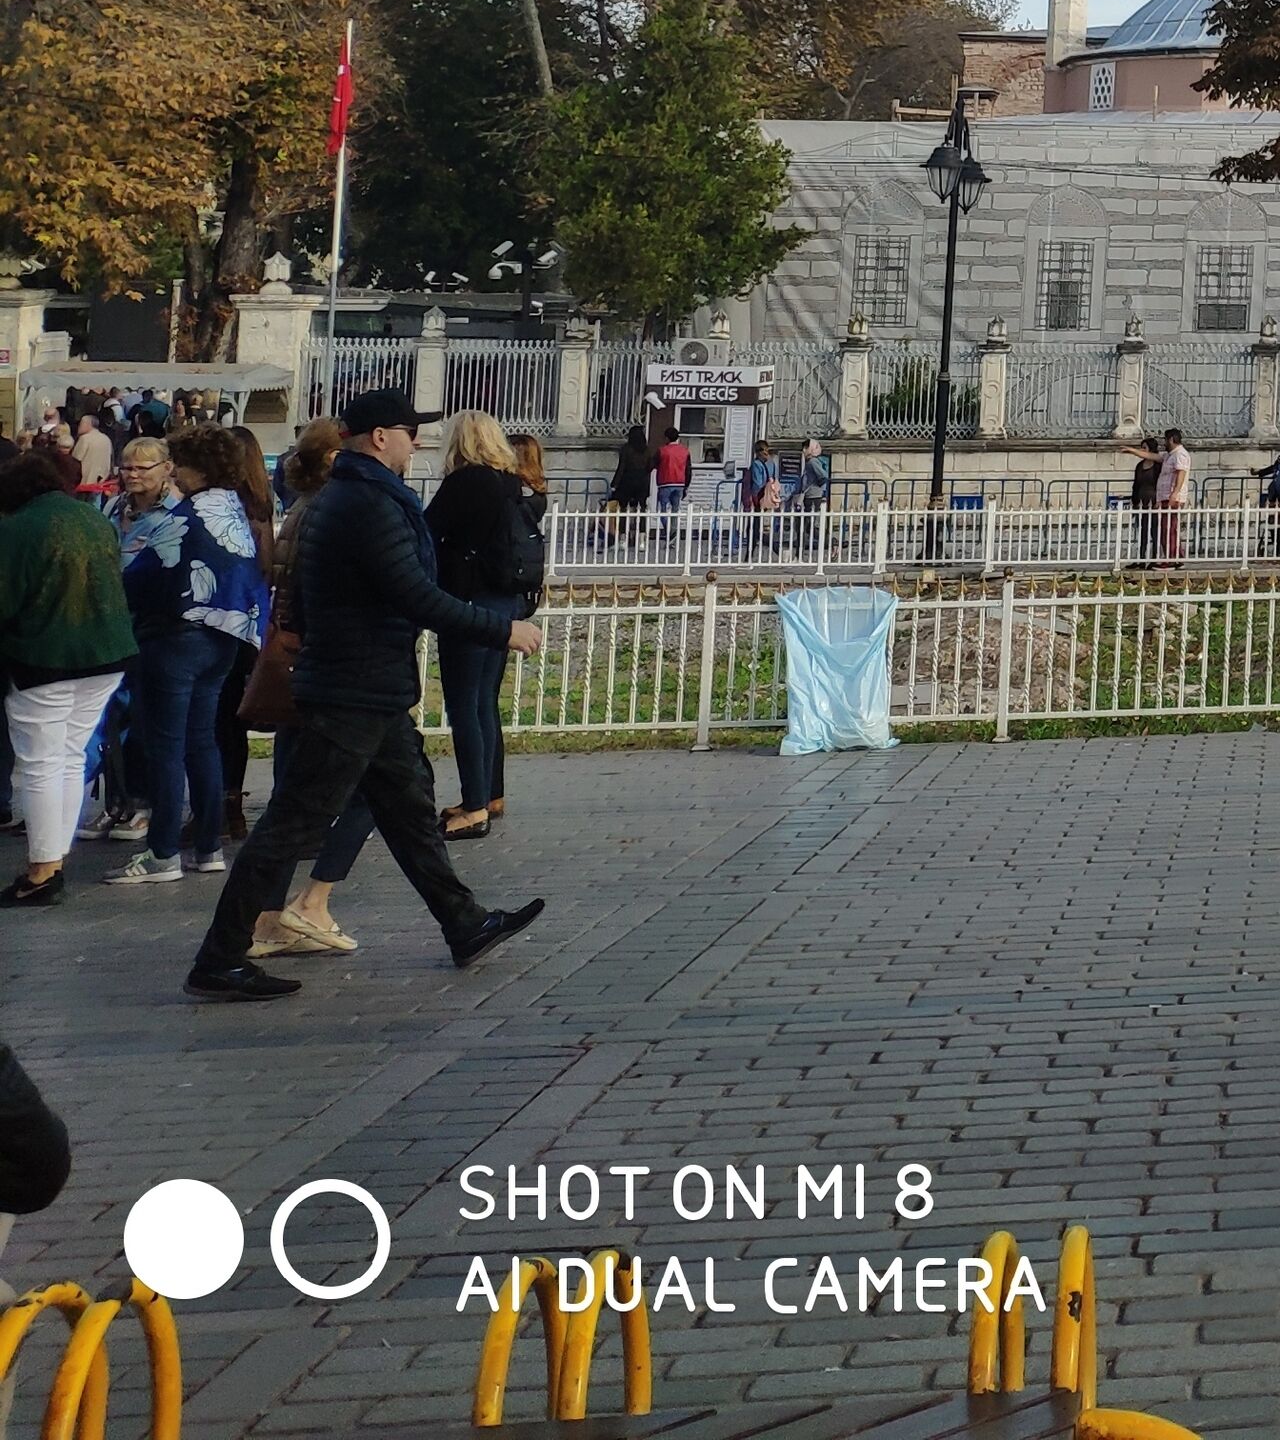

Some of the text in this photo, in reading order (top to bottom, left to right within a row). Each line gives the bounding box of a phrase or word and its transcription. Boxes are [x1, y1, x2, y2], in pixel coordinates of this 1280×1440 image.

[661, 370, 743, 384] FAST TRACK
[663, 386, 696, 400] HIZLI
